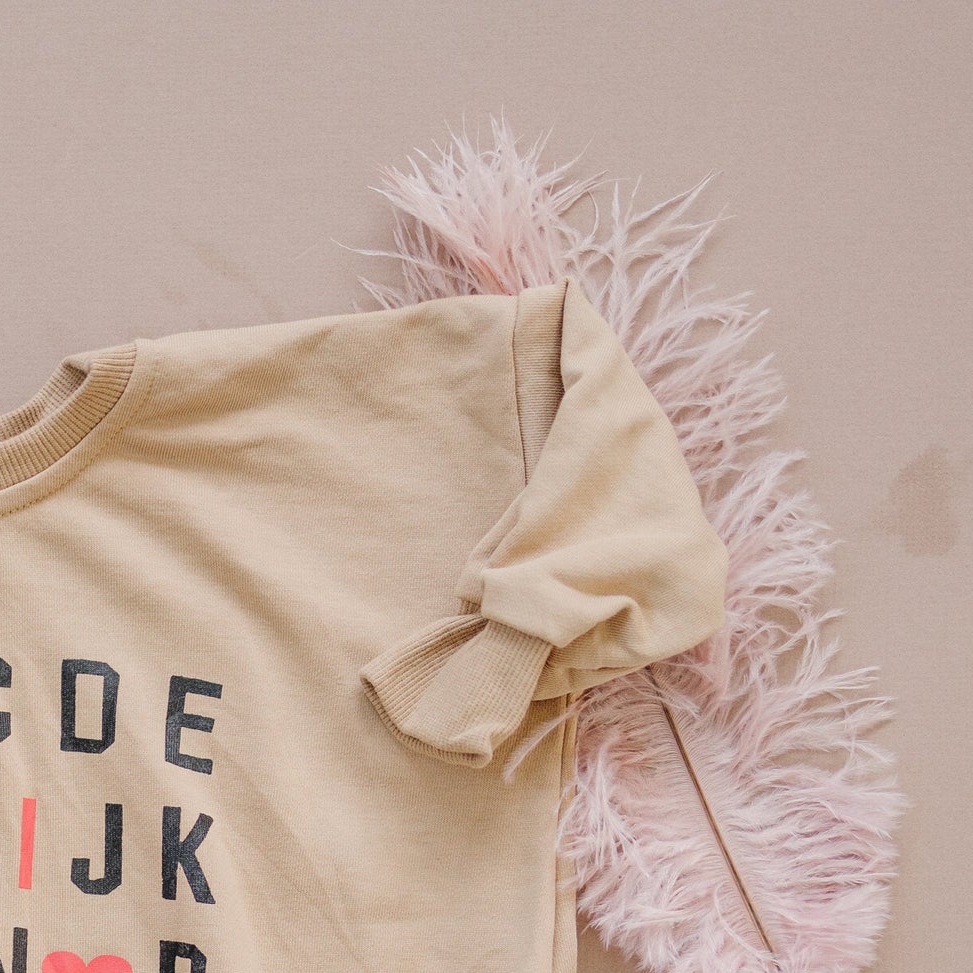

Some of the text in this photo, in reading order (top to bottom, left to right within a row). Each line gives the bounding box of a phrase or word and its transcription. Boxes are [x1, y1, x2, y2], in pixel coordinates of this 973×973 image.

[59, 658, 120, 755] D
[164, 674, 223, 776] E
[18, 797, 37, 890] I
[70, 802, 124, 896] J
[161, 805, 216, 905] K
